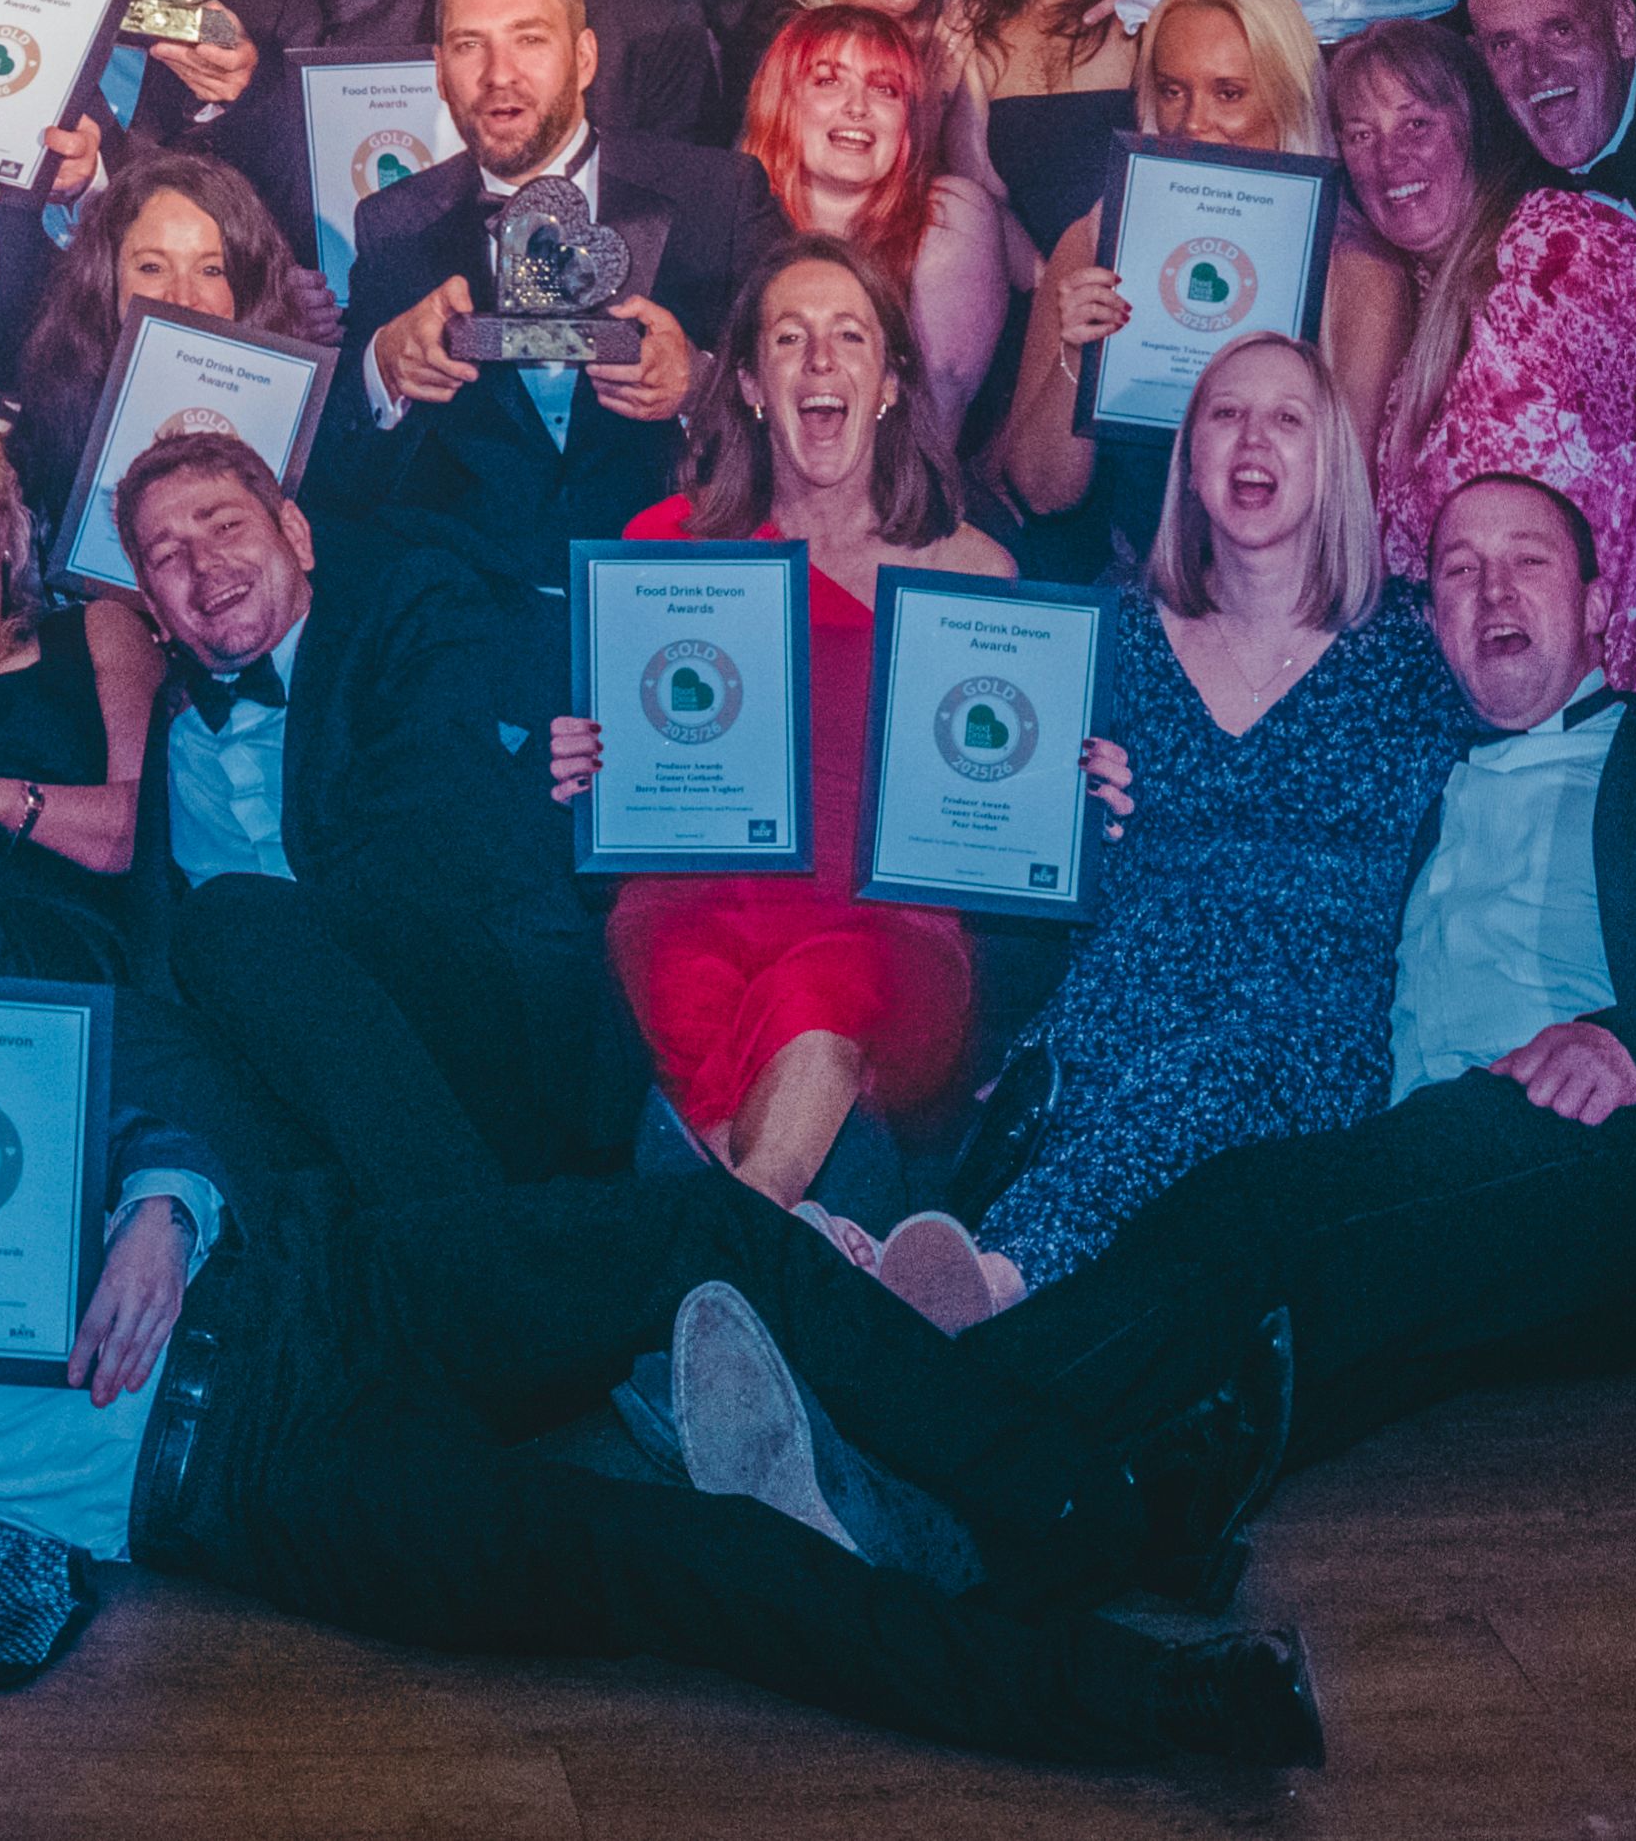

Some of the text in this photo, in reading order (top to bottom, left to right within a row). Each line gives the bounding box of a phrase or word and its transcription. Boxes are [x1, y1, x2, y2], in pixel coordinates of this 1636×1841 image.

[634, 584, 745, 597] Food Drink Devon
[665, 602, 714, 614] Awards
[663, 640, 719, 663] GOLD
[660, 720, 723, 742] 2025/26
[654, 761, 723, 771] Producer Awards
